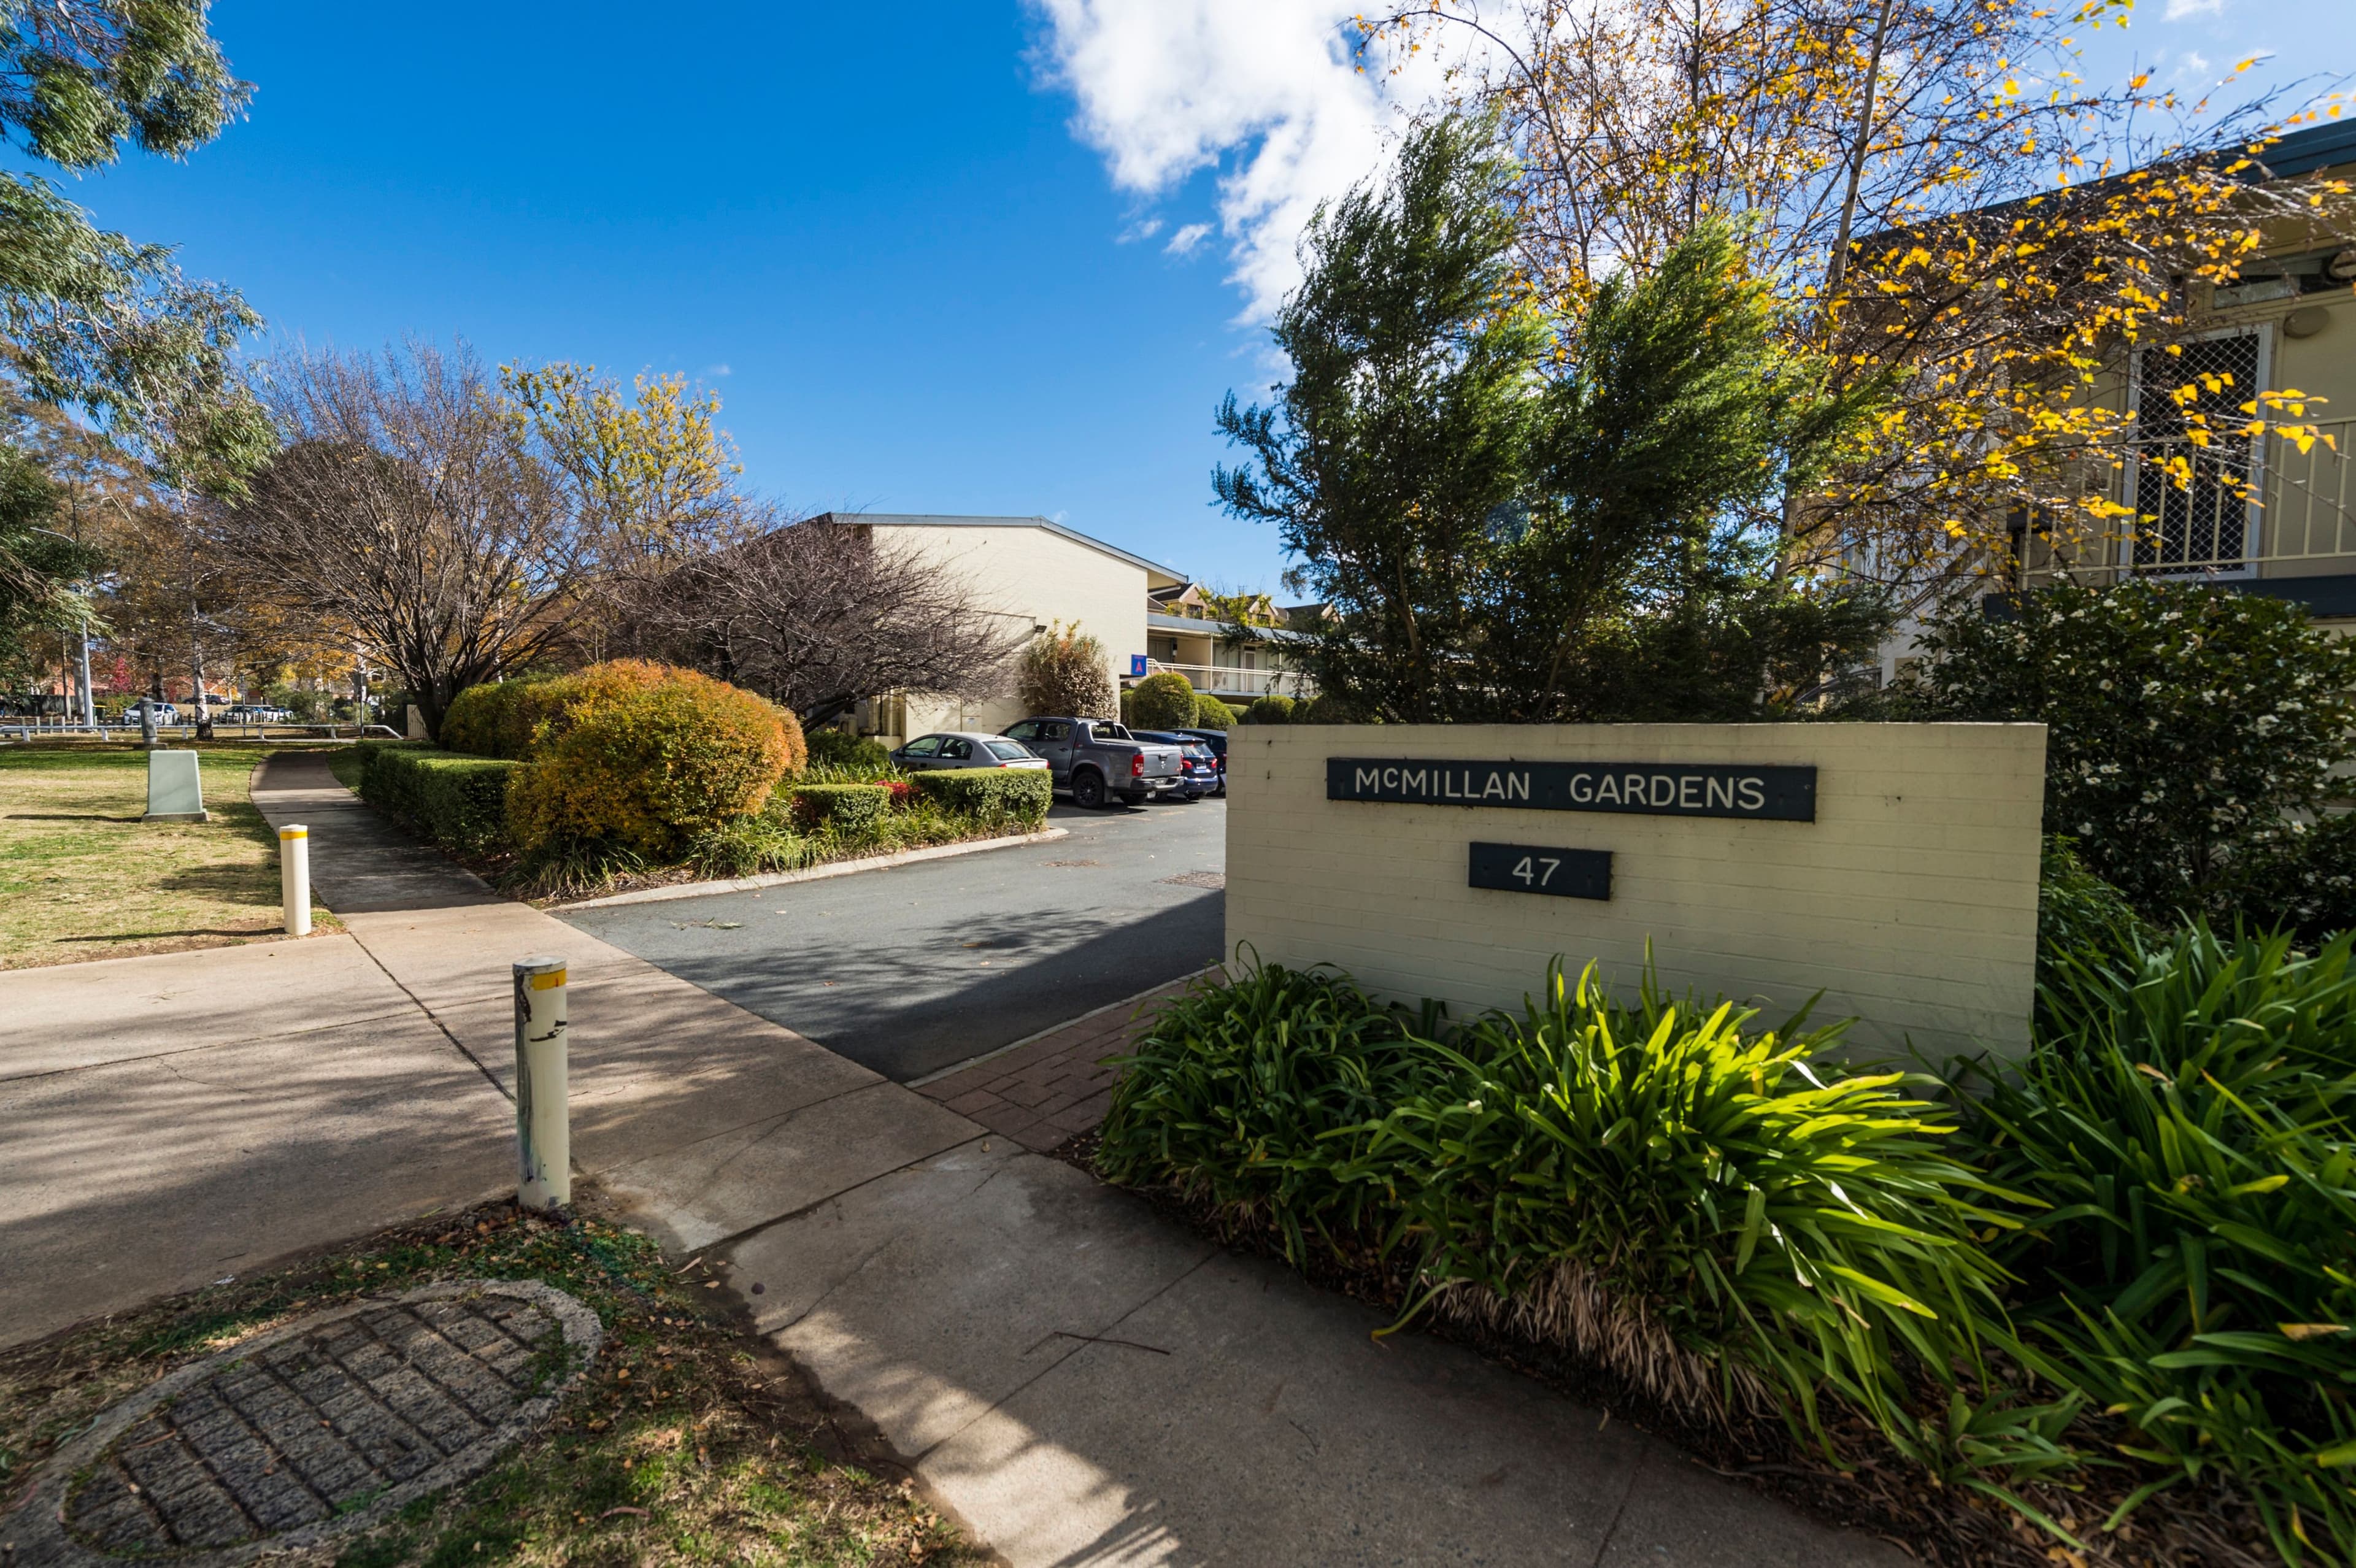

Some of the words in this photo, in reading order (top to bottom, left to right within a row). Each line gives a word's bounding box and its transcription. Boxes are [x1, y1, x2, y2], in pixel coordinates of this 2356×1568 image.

[1135, 661, 1143, 672] A
[1569, 773, 1765, 810] GARDENS
[1512, 856, 1560, 886] 47
